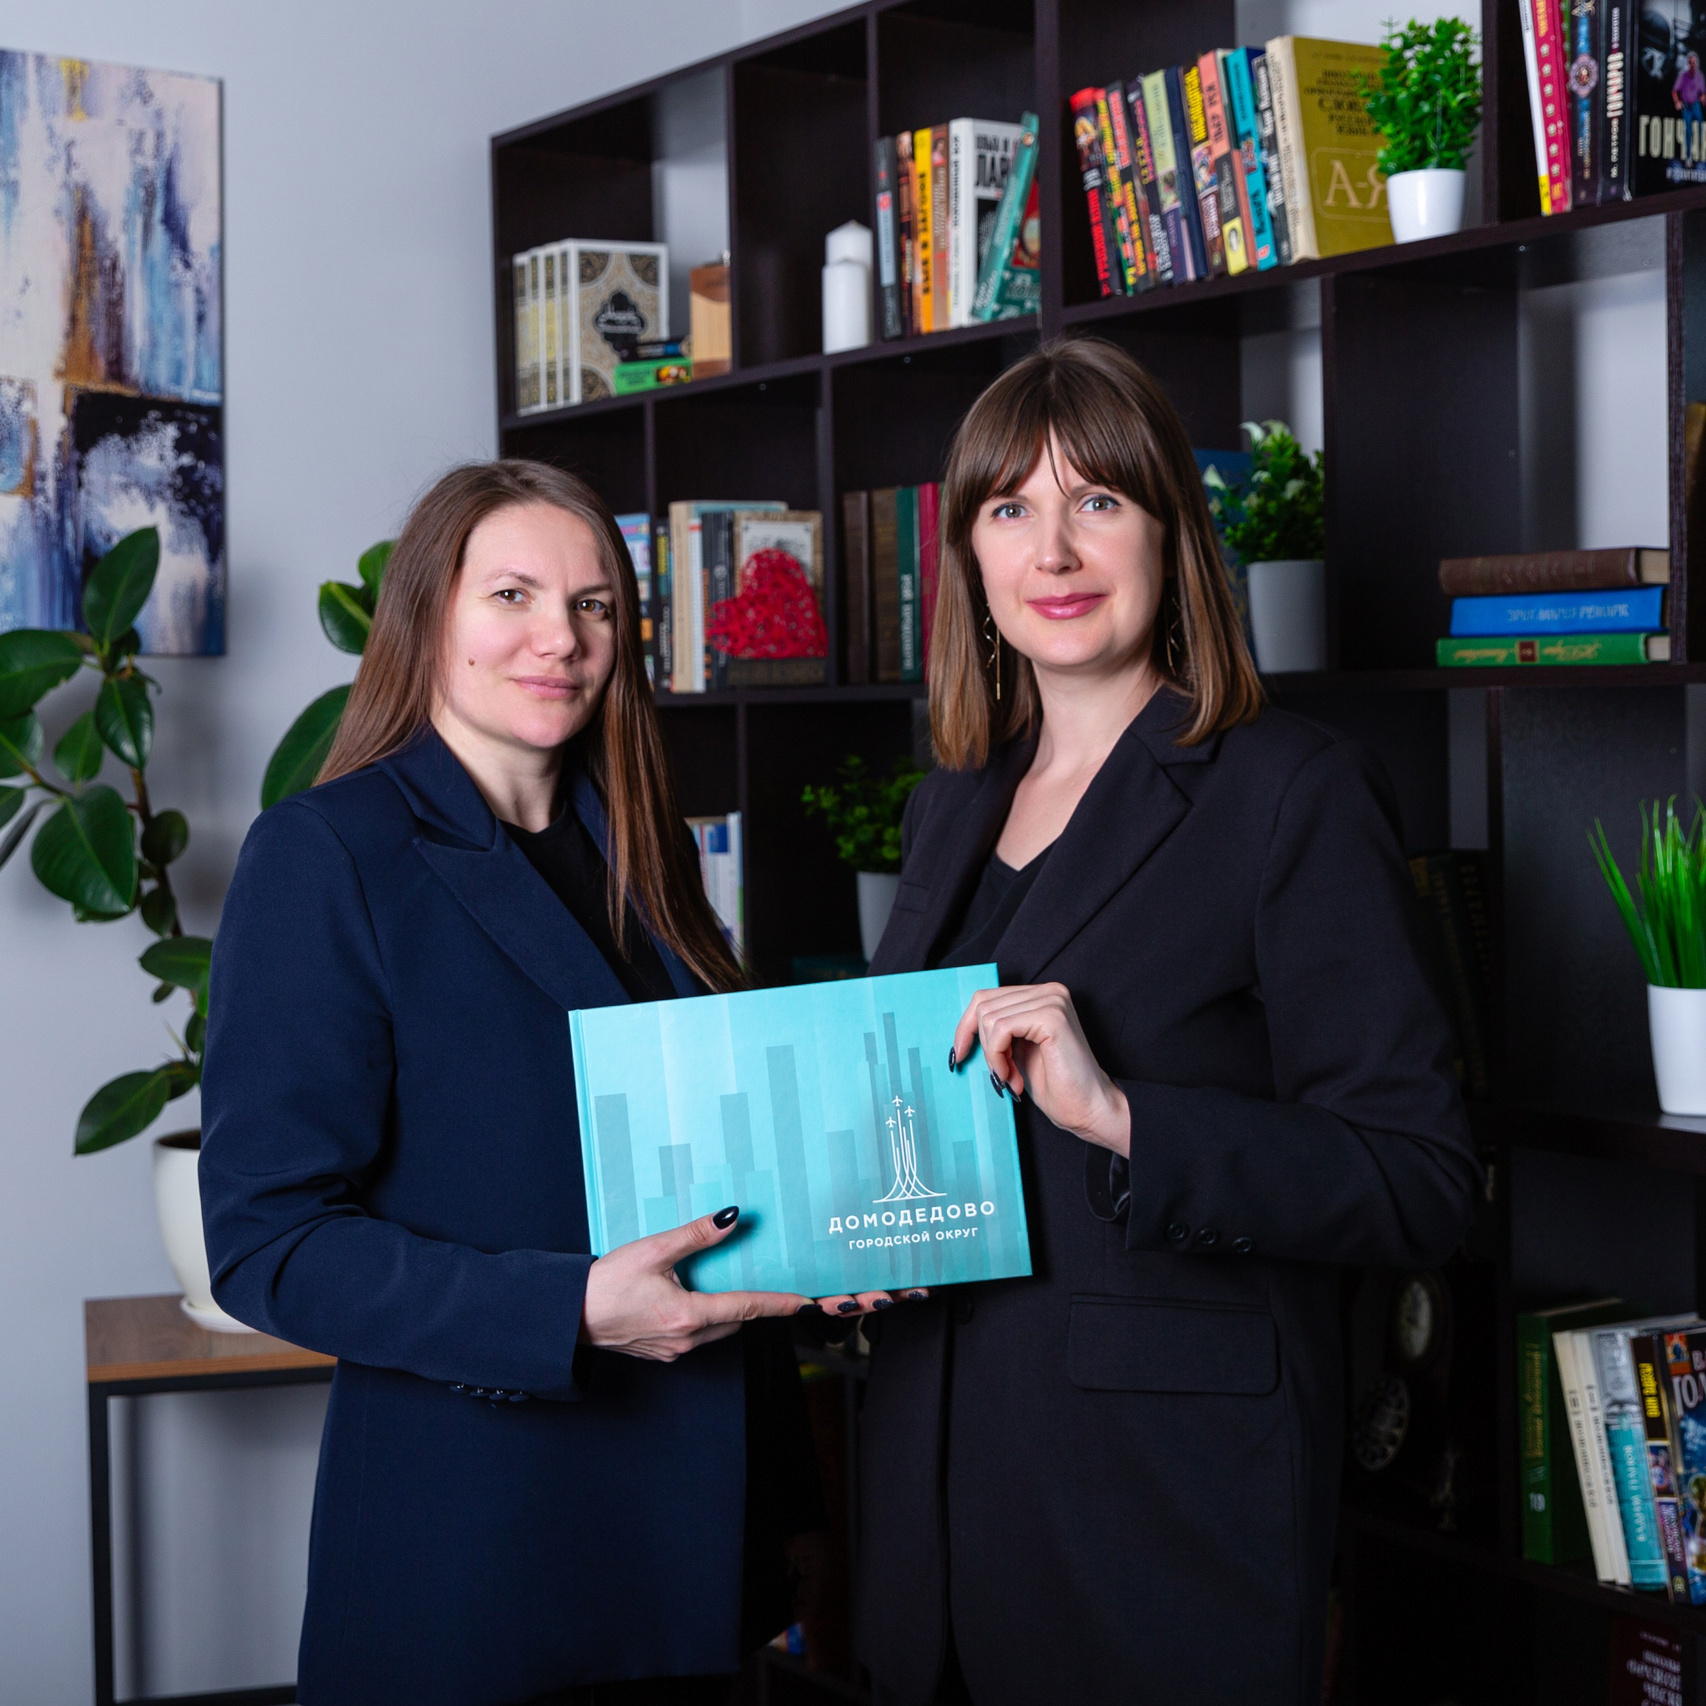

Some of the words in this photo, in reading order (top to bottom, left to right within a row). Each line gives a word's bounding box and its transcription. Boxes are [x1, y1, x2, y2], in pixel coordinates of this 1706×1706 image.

[1607, 52, 1624, 118] ГОНЧАРОВ
[828, 1200, 995, 1235] ДОМОДЕДОВО
[848, 1231, 931, 1250] ГОРОДСКОЙ
[935, 1226, 979, 1242] ОКРУГ
